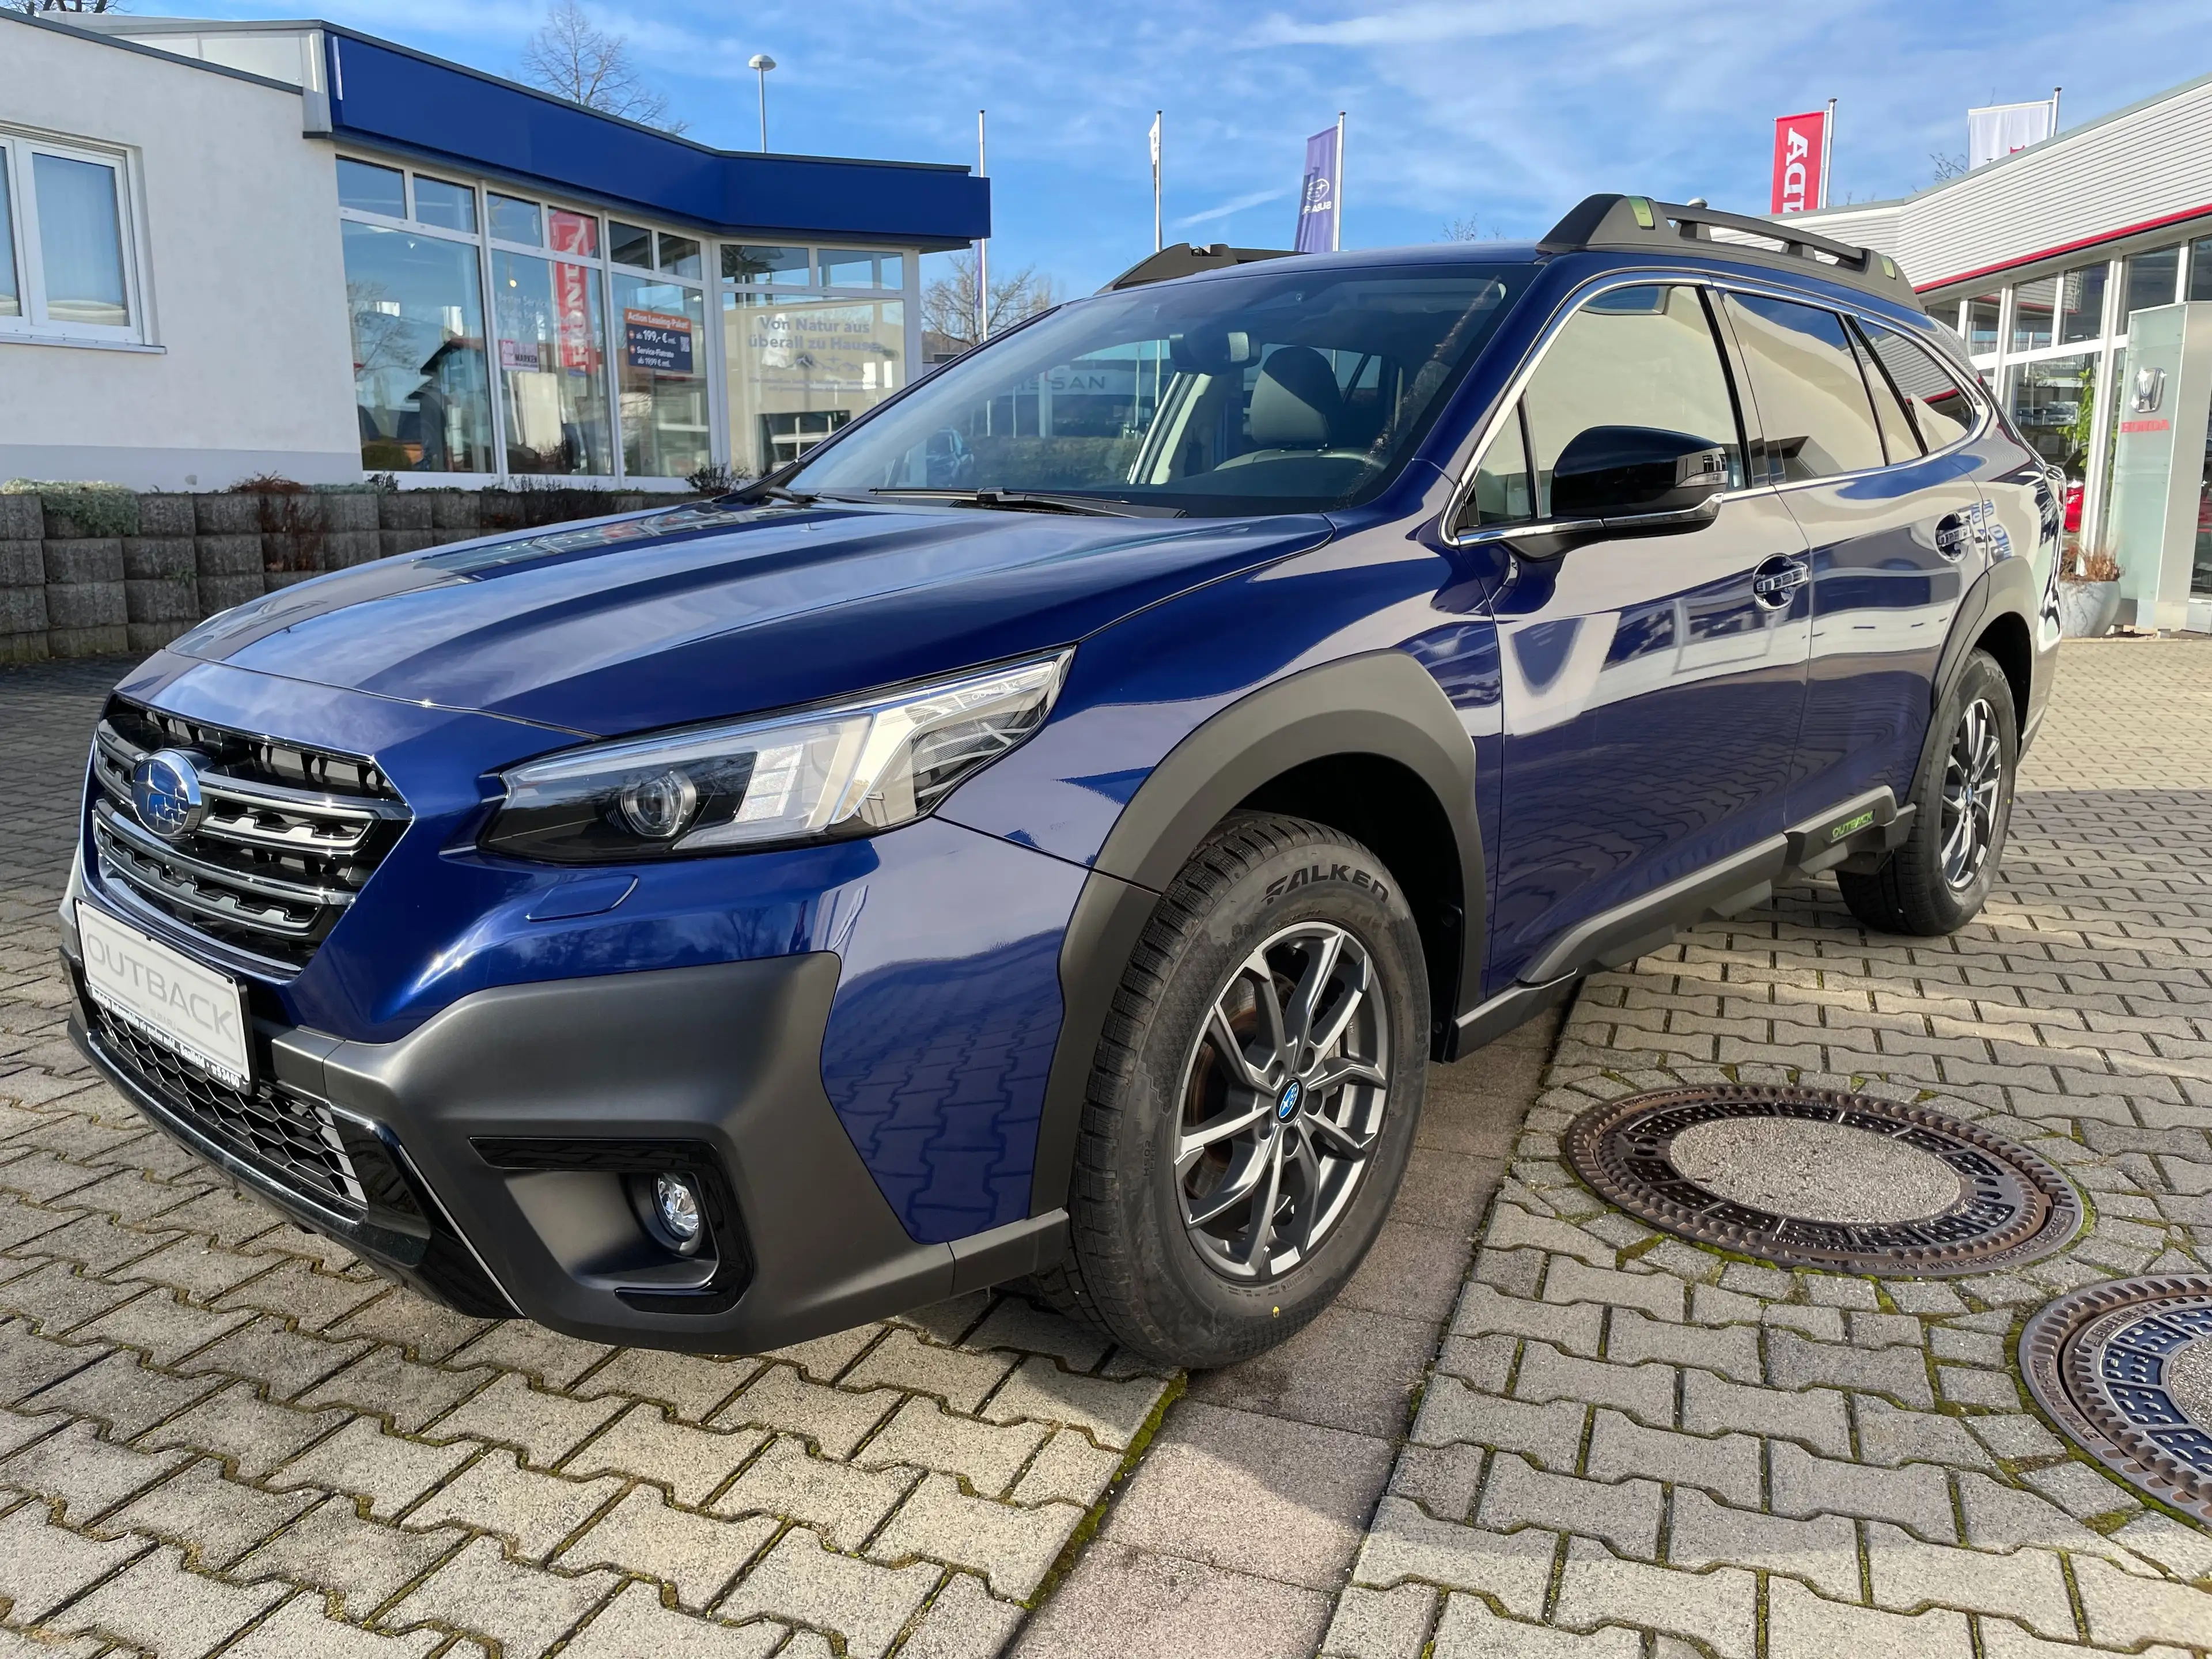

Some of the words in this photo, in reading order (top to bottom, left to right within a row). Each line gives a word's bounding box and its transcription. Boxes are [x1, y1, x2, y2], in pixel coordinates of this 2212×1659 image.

[759, 316, 790, 331] Von
[796, 317, 839, 333] Natur
[843, 322, 870, 334] aus
[748, 334, 804, 350] überall
[808, 339, 827, 350] zu
[2120, 419, 2171, 433] HONDA
[1832, 810, 1874, 838] OUTBACK
[1261, 863, 1389, 906] FALKEN
[86, 933, 237, 1043] OUTBACK
[179, 1043, 206, 1069] Saalfeld
